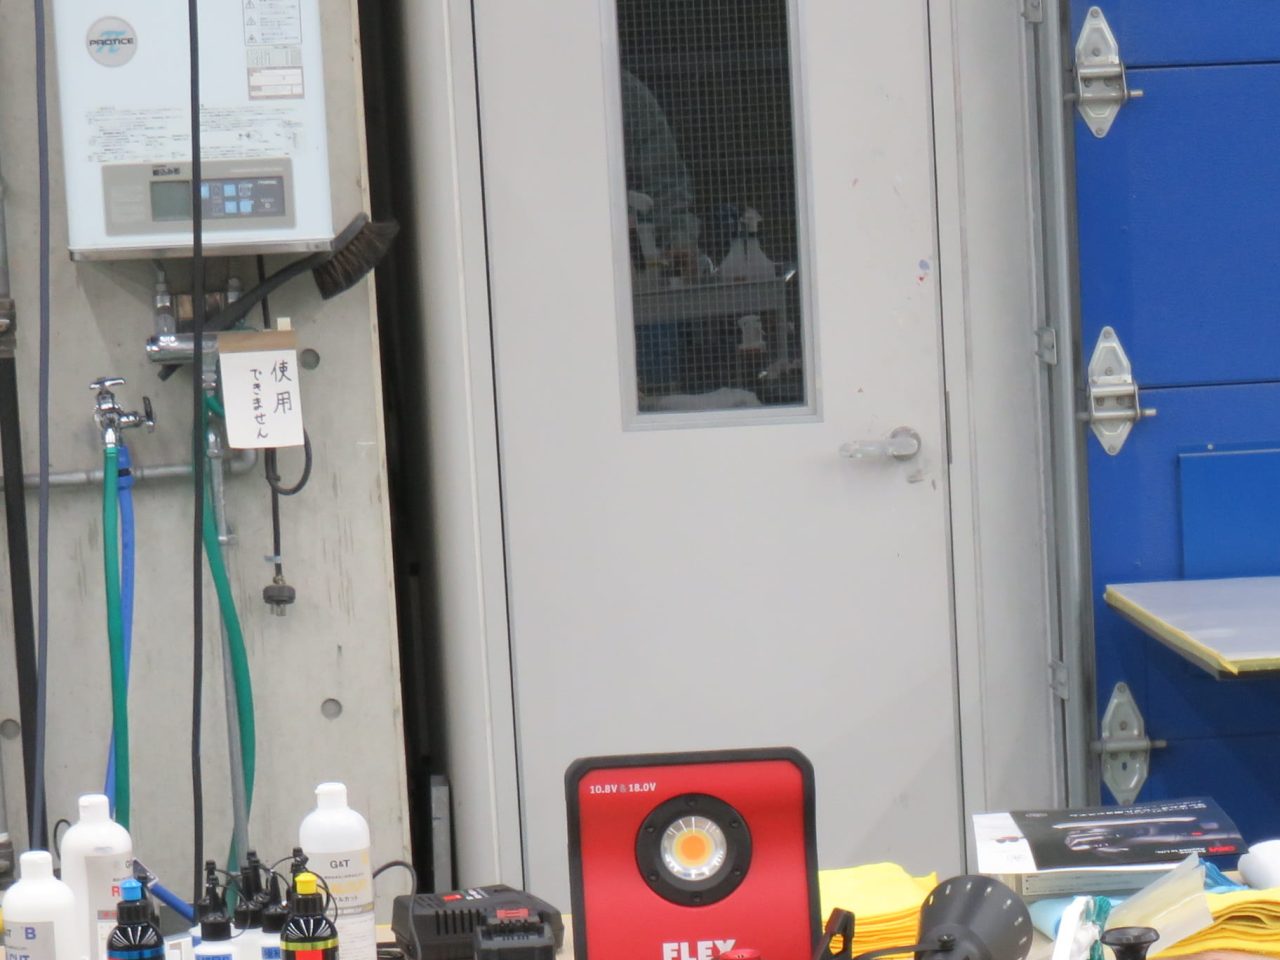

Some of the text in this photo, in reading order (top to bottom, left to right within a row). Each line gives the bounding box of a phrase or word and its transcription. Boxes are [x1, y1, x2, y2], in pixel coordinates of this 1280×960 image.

[249, 367, 270, 440] できません
[270, 359, 293, 415] 使用
[589, 783, 618, 795] 10.8V
[628, 781, 657, 793] 18.0V
[24, 926, 36, 940] B
